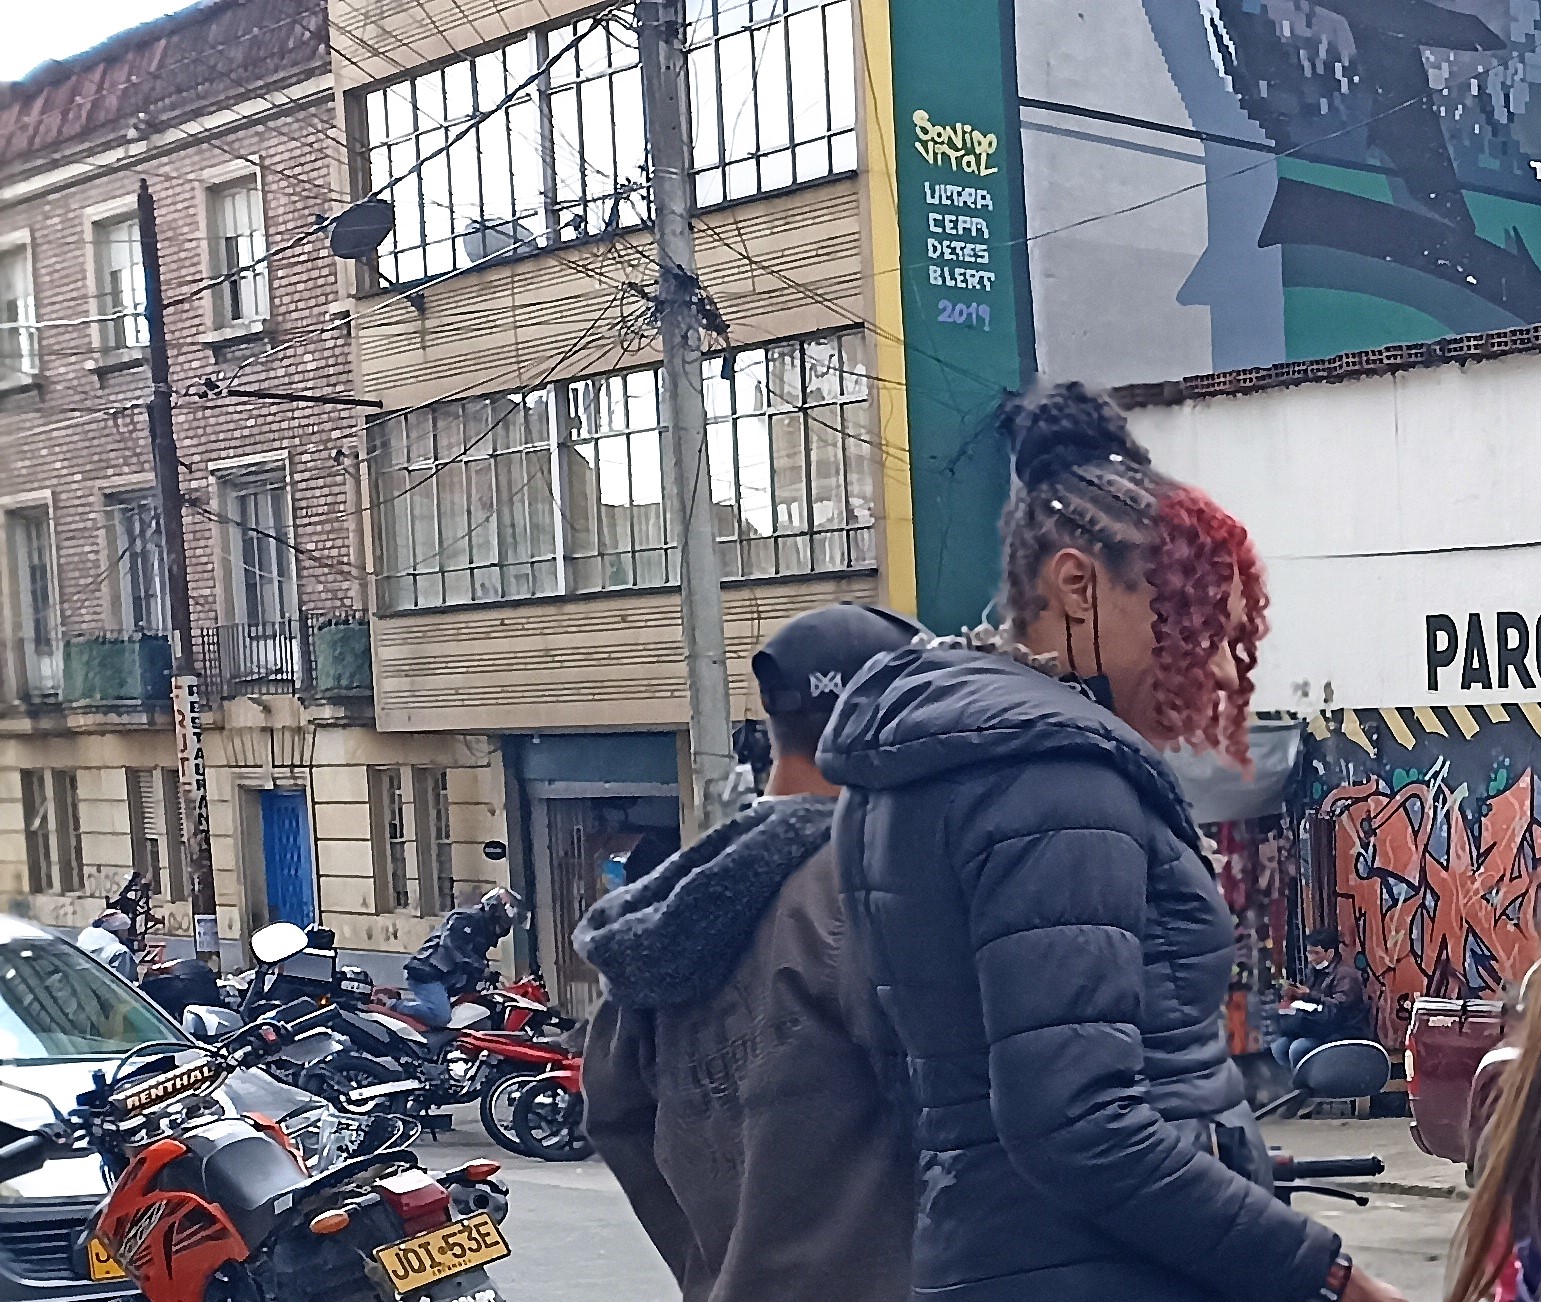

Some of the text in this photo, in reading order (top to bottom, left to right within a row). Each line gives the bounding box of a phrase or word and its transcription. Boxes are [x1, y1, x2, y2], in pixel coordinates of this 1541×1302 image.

[924, 181, 993, 211] ULTRA
[929, 266, 995, 291] BLERT
[938, 299, 990, 331] 2019
[126, 1066, 214, 1110] RENTHAL
